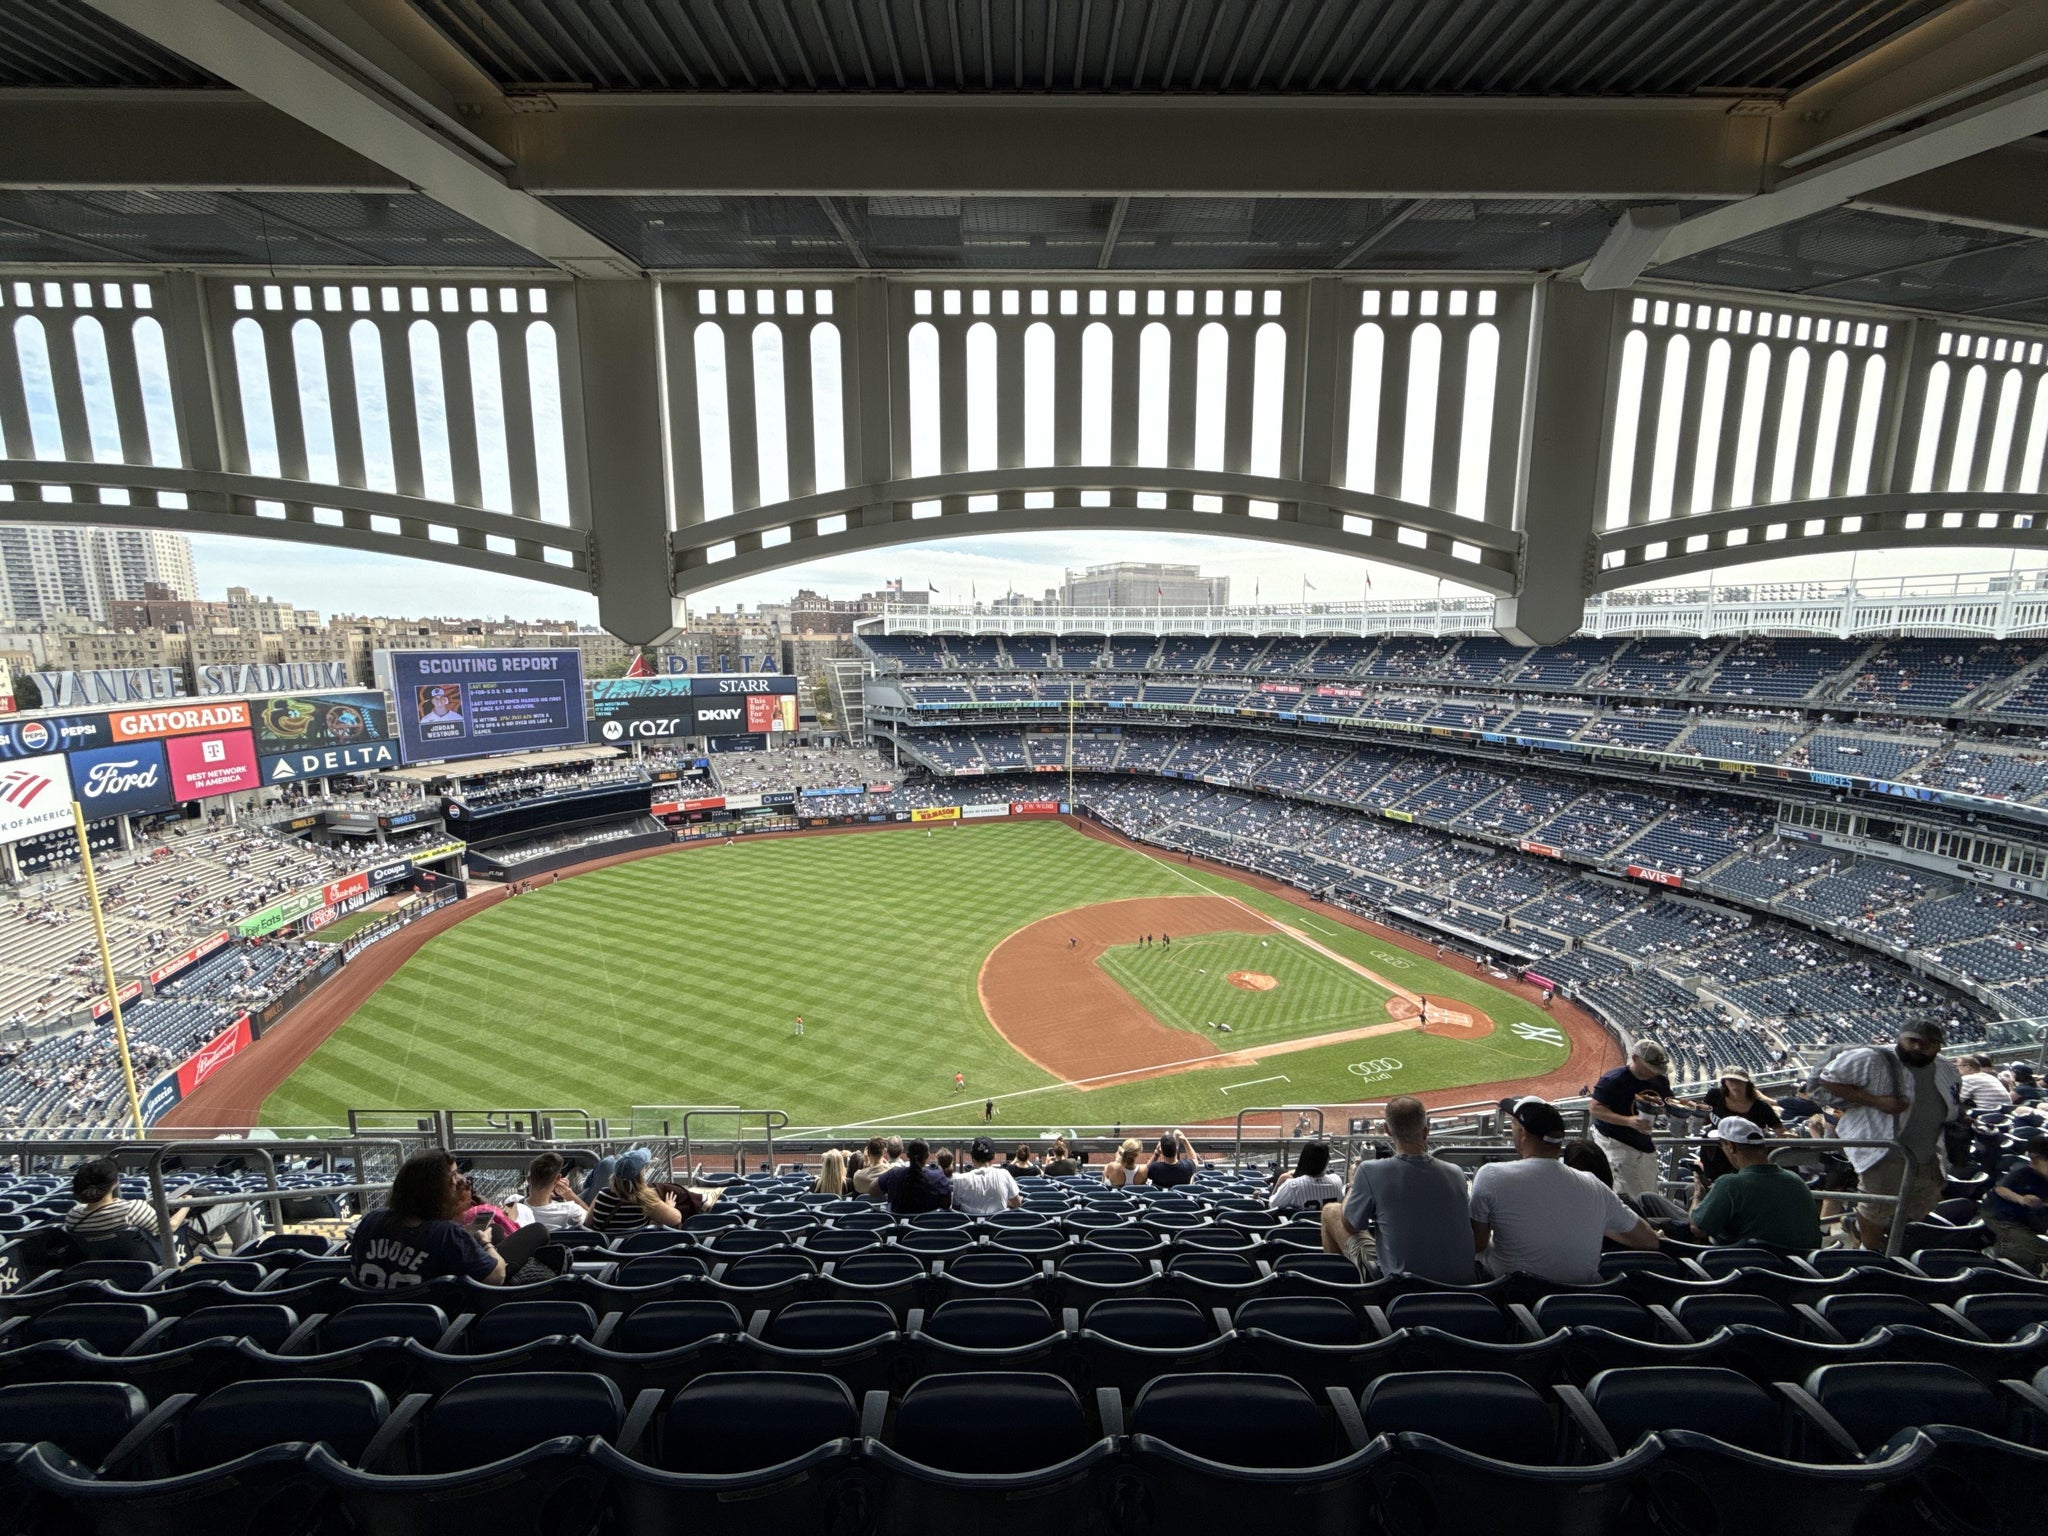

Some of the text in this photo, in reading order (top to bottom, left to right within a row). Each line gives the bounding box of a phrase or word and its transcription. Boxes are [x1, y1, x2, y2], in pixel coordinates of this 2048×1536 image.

[419, 657, 559, 674] SCOUTING REPORT
[668, 655, 778, 674] DELTA
[28, 662, 347, 709] YANKEE STADIUM
[719, 679, 770, 693] STARR
[120, 706, 244, 735] GATORADE
[697, 708, 742, 721] DKNY
[25, 731, 46, 739] PEPSI
[61, 724, 97, 737] PEPSI
[427, 729, 460, 738] WESTBURG
[430, 724, 455, 732] JORDAN
[629, 718, 680, 737] razr
[302, 745, 392, 773] DELTA
[84, 760, 158, 798] Ford
[186, 765, 247, 782] BEST NETWORK
[1719, 761, 1756, 774] ORIOLES
[1809, 772, 1853, 788] YANKEES
[195, 775, 242, 789] IN AMERICA
[10, 820, 24, 829] OF
[26, 808, 73, 826] AMERICA
[391, 814, 417, 826] YANKEES
[1842, 838, 1868, 847] DELTA
[383, 864, 406, 877] coupa
[1639, 869, 1668, 883] AVIS
[341, 885, 388, 914] A SUB ABOVE
[261, 914, 281, 930] Eats
[1510, 1022, 1565, 1047] NY
[1363, 1072, 1393, 1084] Audi
[366, 1238, 429, 1272] JUDGE
